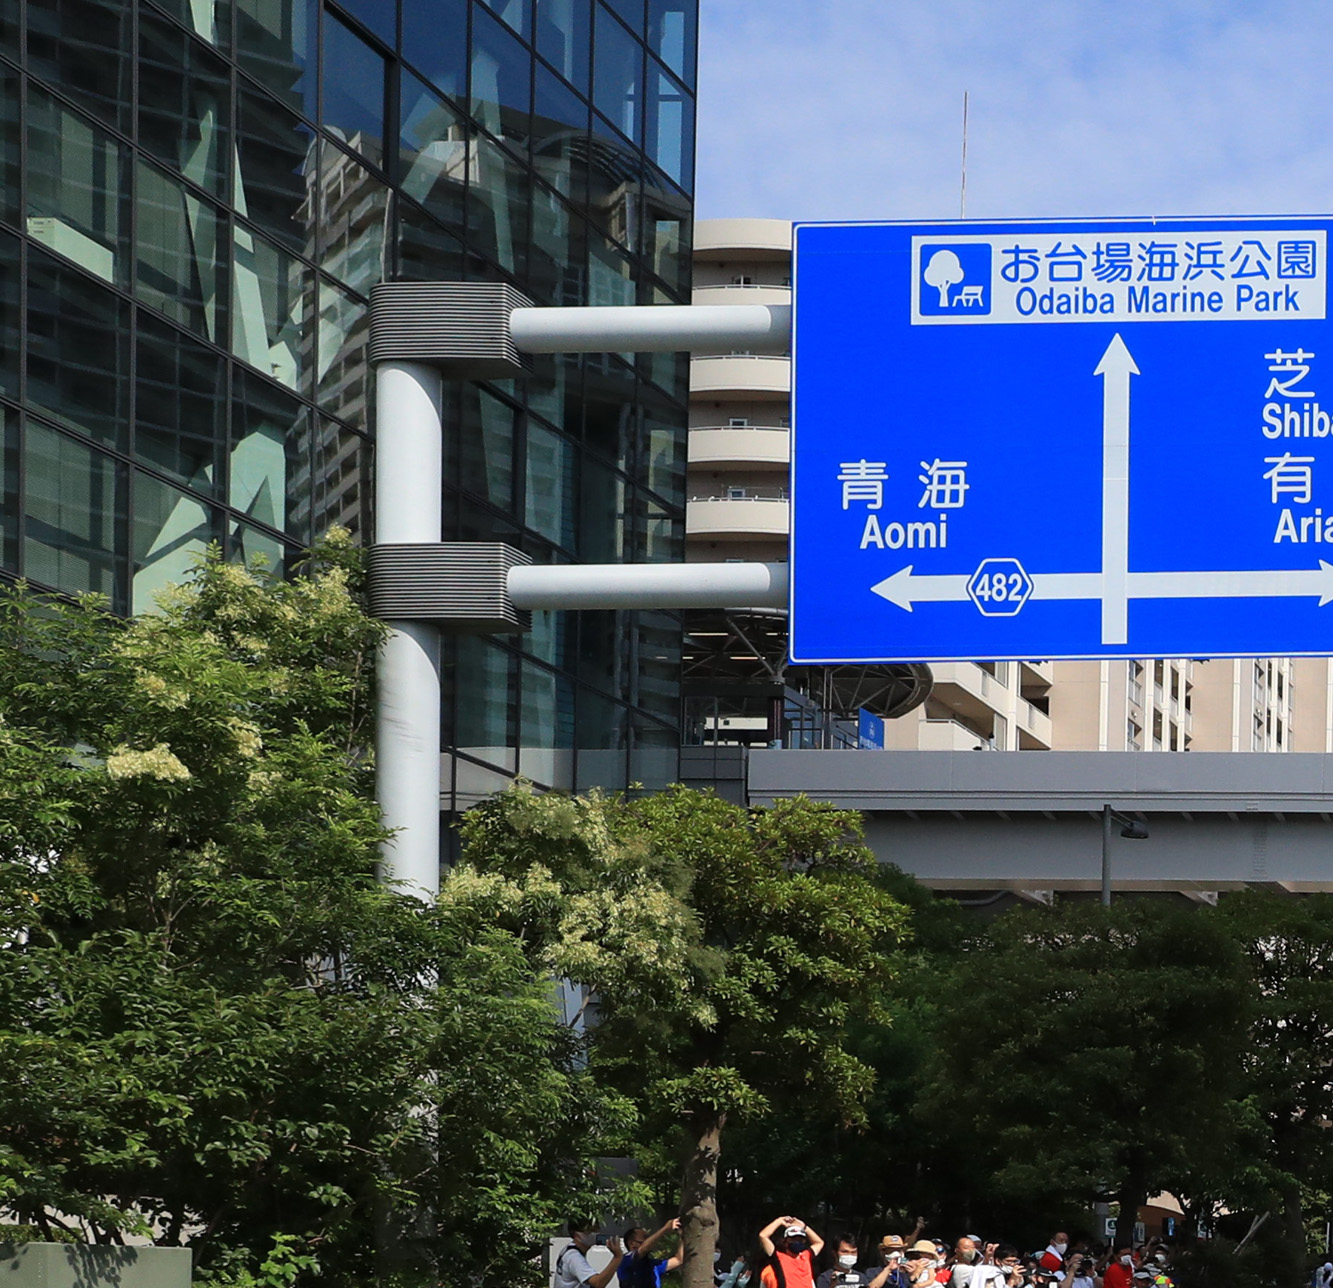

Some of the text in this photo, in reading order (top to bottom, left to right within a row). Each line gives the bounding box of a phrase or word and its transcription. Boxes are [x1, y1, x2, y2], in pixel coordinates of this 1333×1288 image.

[1001, 239, 1317, 284] お台場海浜公園
[1015, 282, 1301, 316] Odaiba Marine Park
[837, 458, 970, 510] 青海
[859, 514, 948, 550] Aomi
[974, 572, 1024, 603] 482
